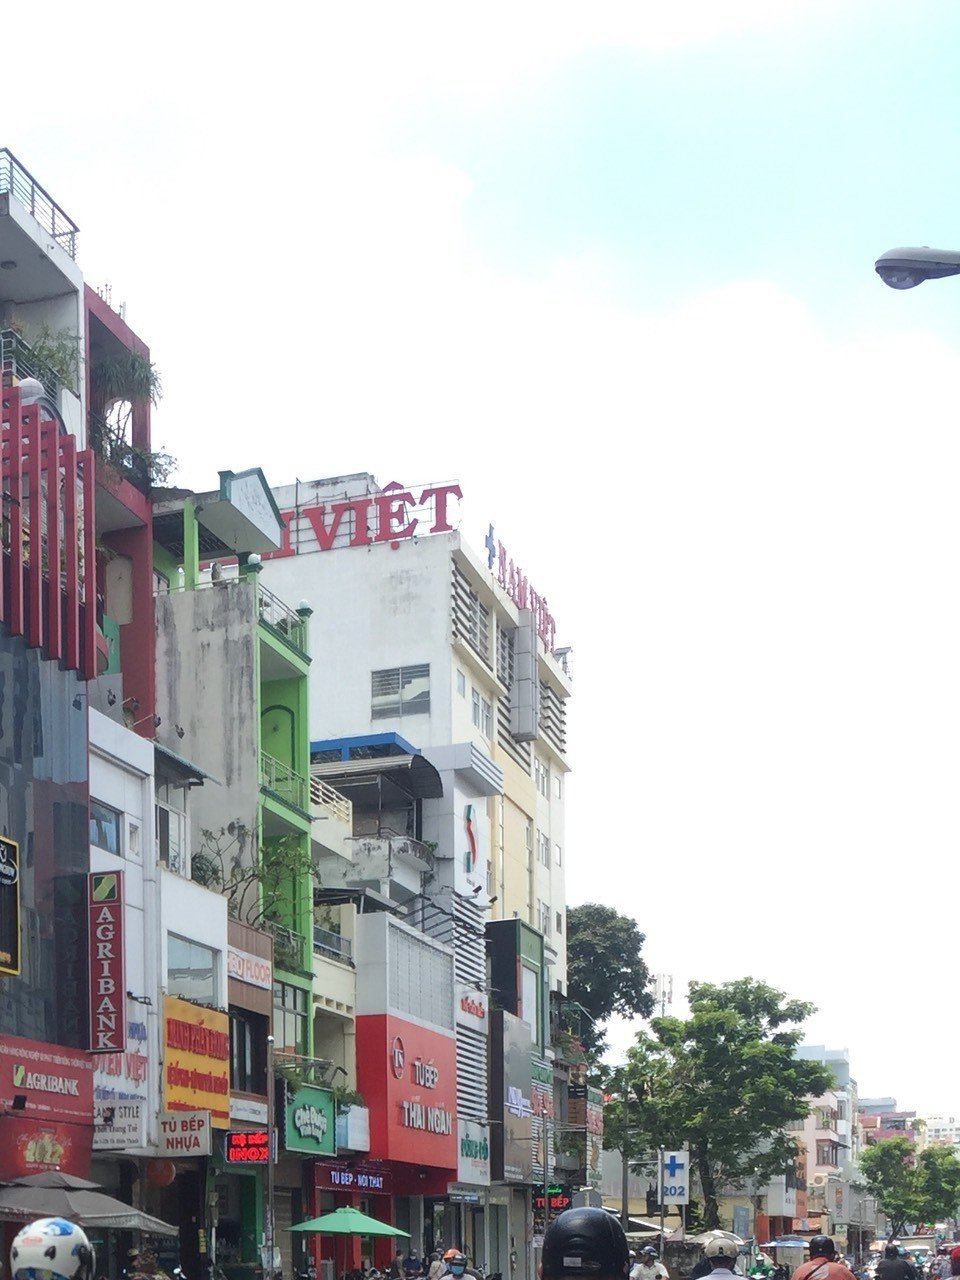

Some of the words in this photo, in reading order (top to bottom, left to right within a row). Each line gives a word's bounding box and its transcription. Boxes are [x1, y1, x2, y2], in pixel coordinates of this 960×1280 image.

[302, 481, 463, 551] VIỆT
[95, 906, 116, 1049] AGRIBANK
[25, 1072, 80, 1097] AGRIBANK
[118, 1105, 140, 1119] STYLE
[161, 1116, 177, 1133] TỦ
[180, 1114, 205, 1132] BẾP
[166, 1134, 201, 1150] NHỰA
[229, 1147, 269, 1161] INOX
[663, 1185, 685, 1197] 202
